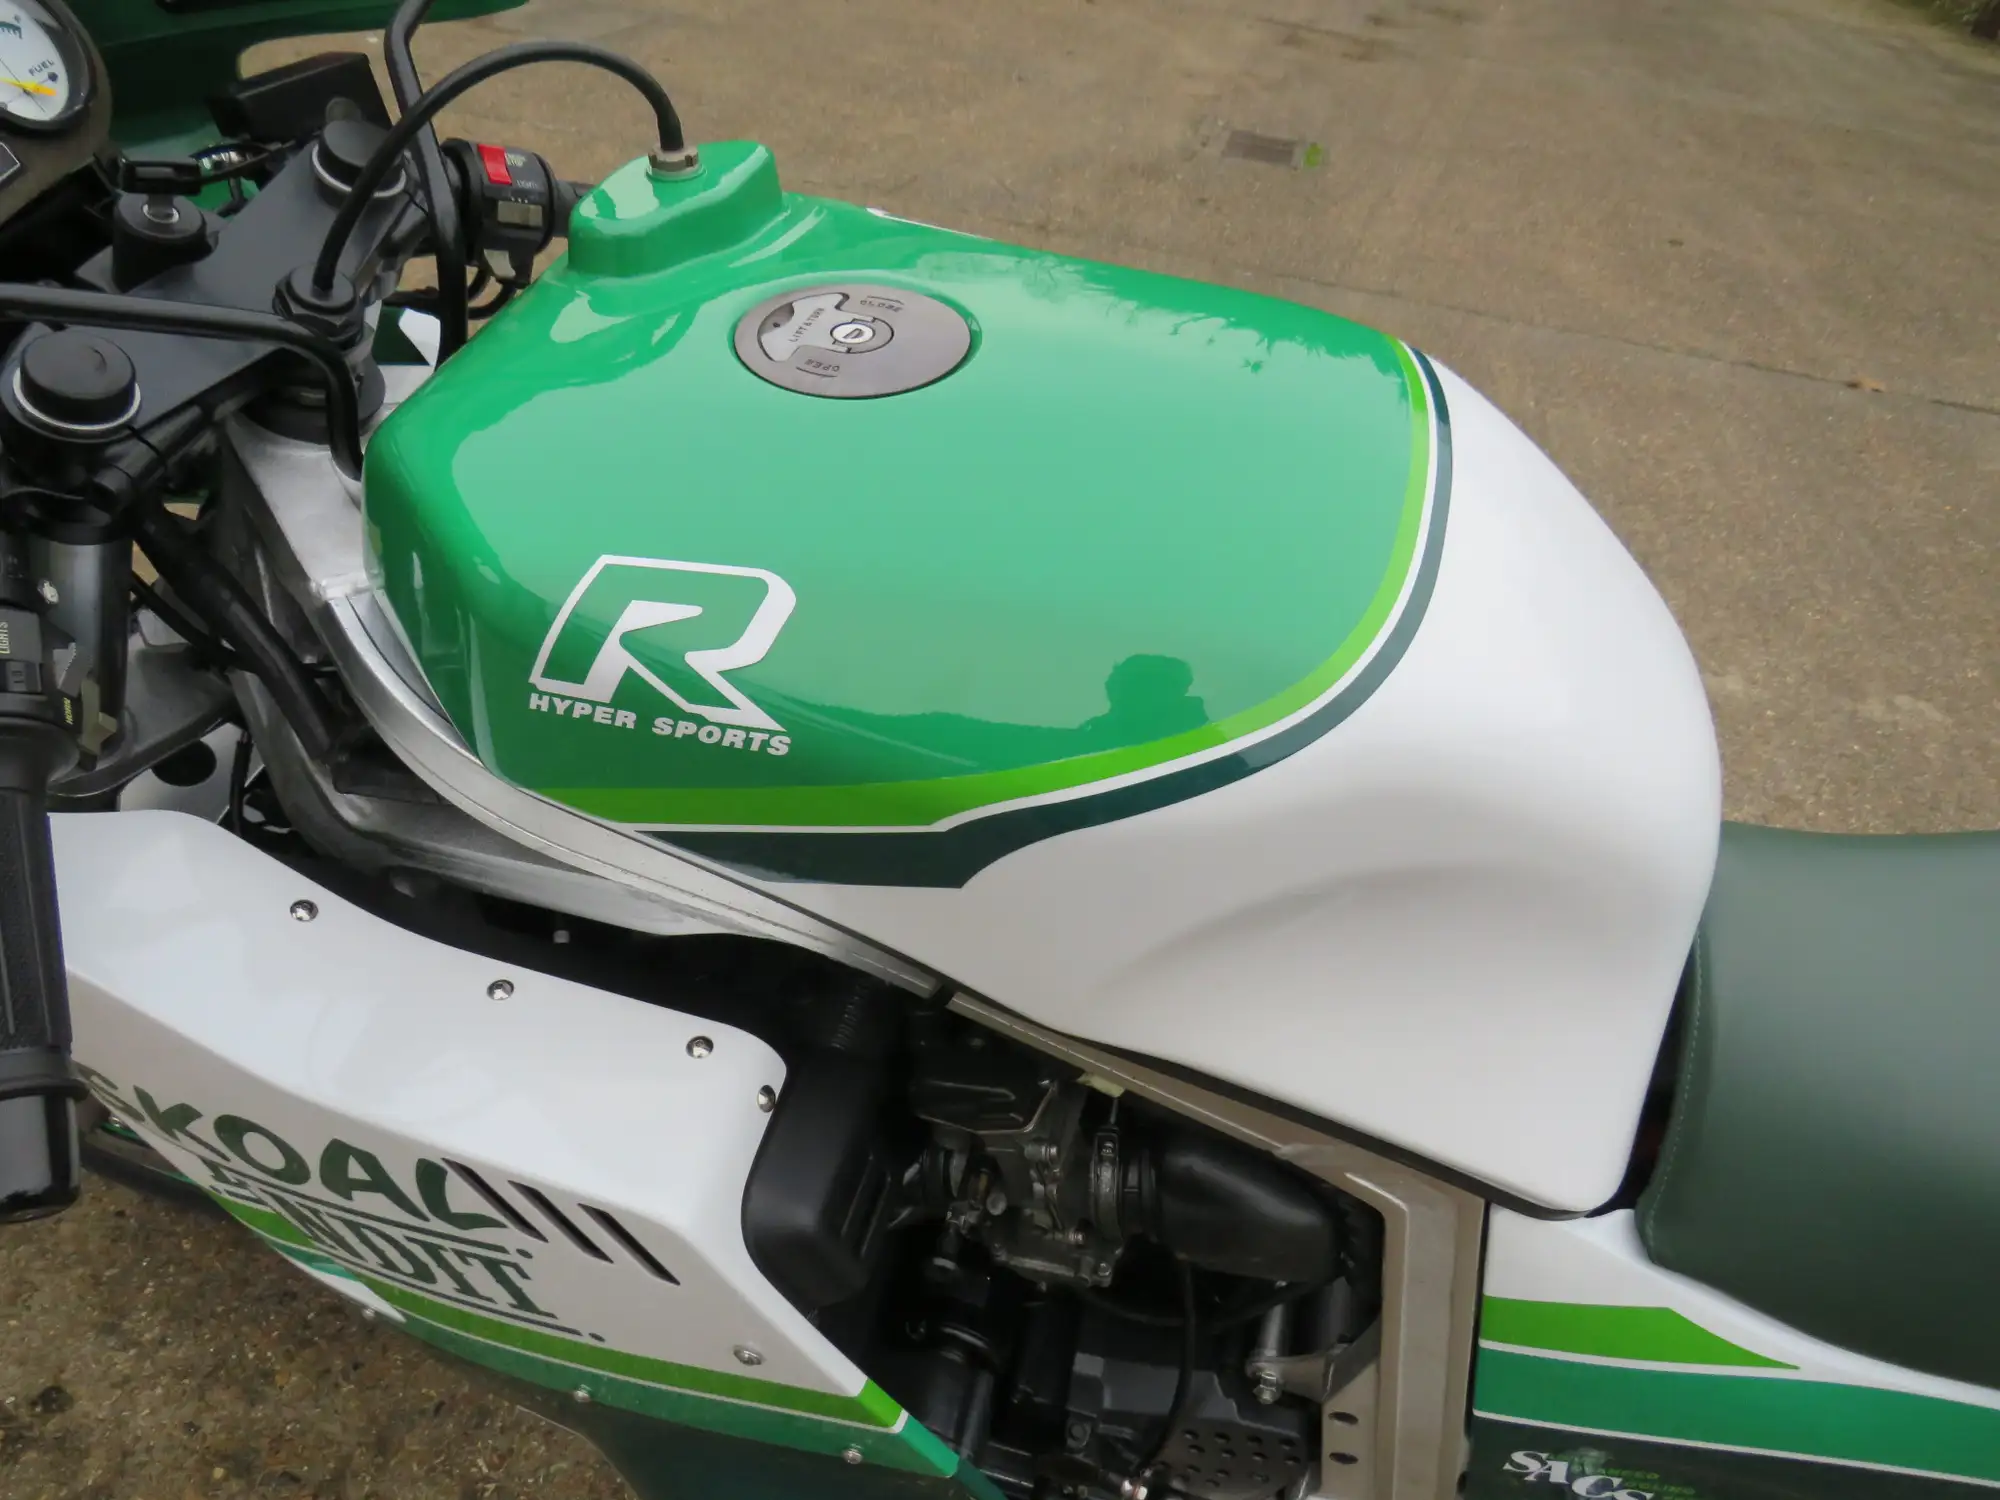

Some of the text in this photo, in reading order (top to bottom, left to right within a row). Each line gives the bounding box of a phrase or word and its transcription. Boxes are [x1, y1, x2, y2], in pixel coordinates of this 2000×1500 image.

[28, 59, 54, 76] FUEL
[860, 300, 903, 312] CLOSE
[528, 554, 797, 732] R
[528, 692, 792, 756] HYPER SPORTS
[73, 1060, 508, 1231] SKOAL
